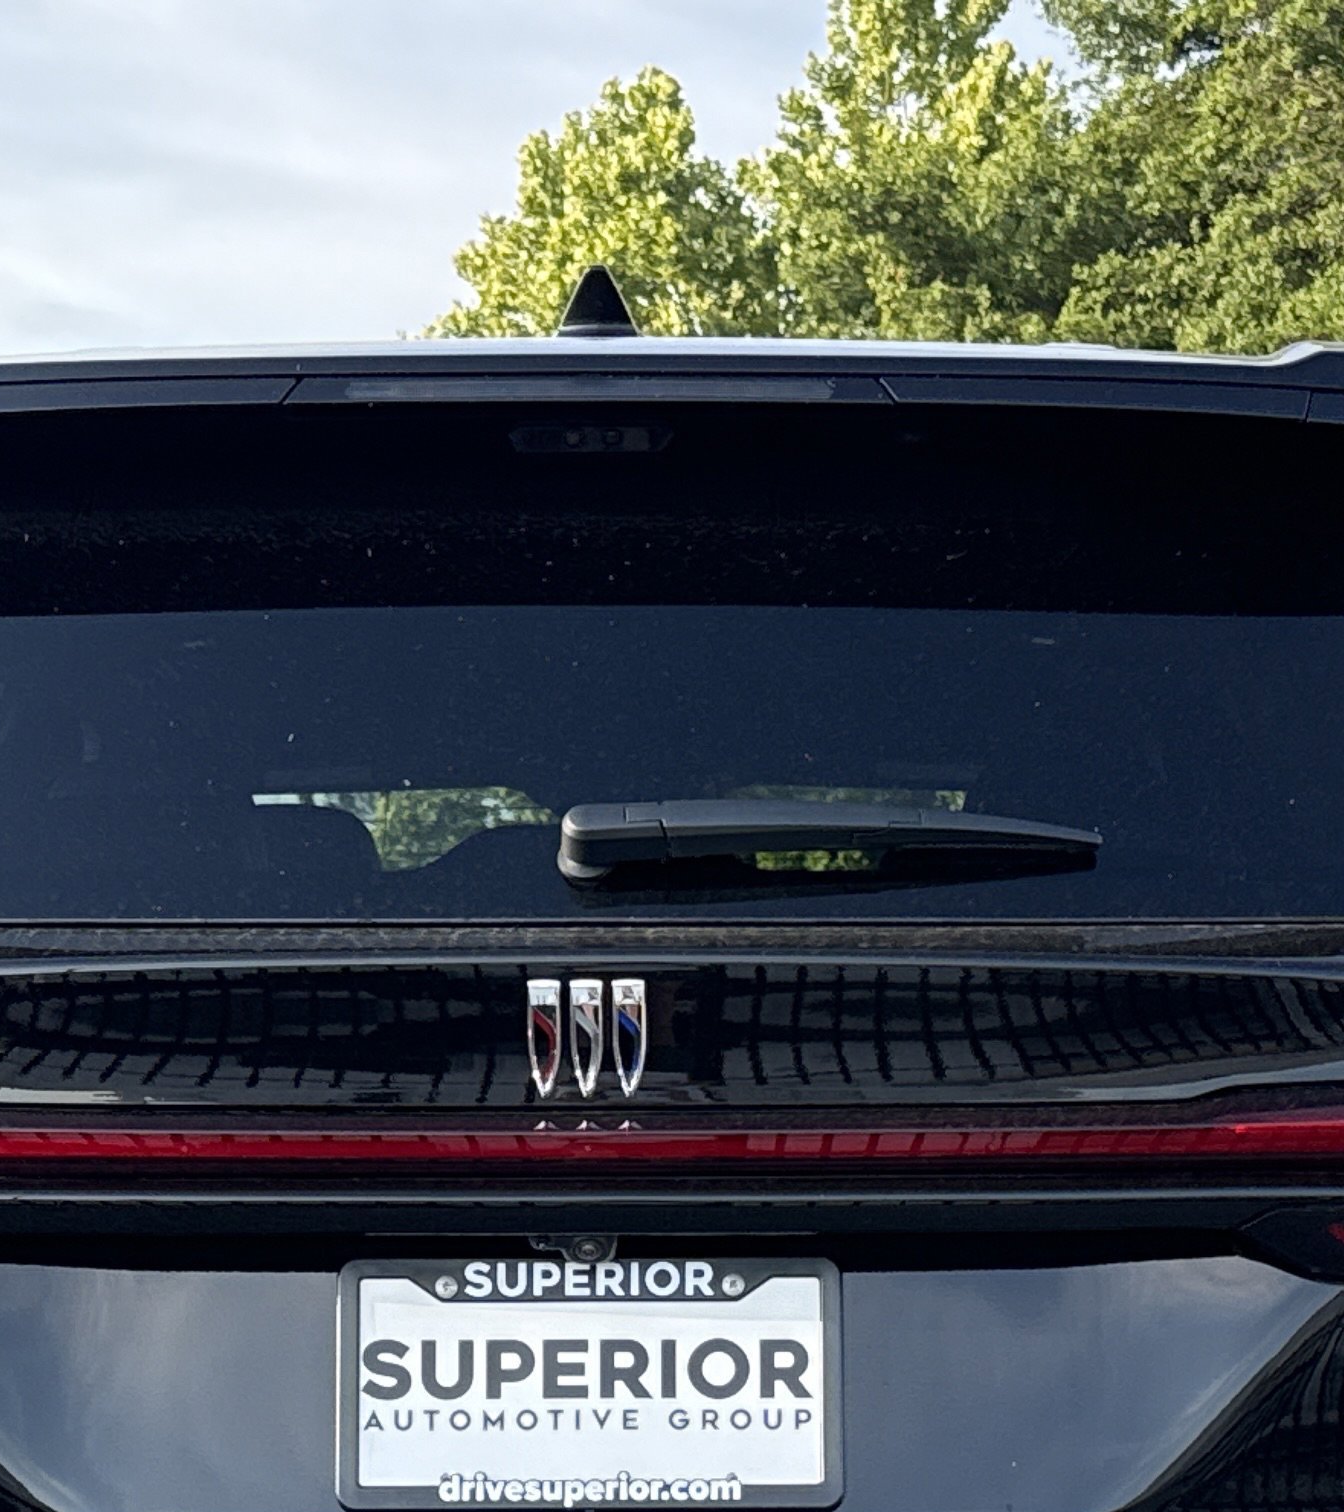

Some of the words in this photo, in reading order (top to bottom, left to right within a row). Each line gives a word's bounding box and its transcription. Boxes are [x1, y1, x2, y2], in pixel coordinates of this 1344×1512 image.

[464, 1261, 714, 1297] SUPERIOR
[362, 1338, 813, 1400] SUPERIOR
[364, 1409, 640, 1430] AUTOMOTIVE
[668, 1409, 813, 1430] GROUP
[438, 1471, 742, 1508] drivesuperior.com
